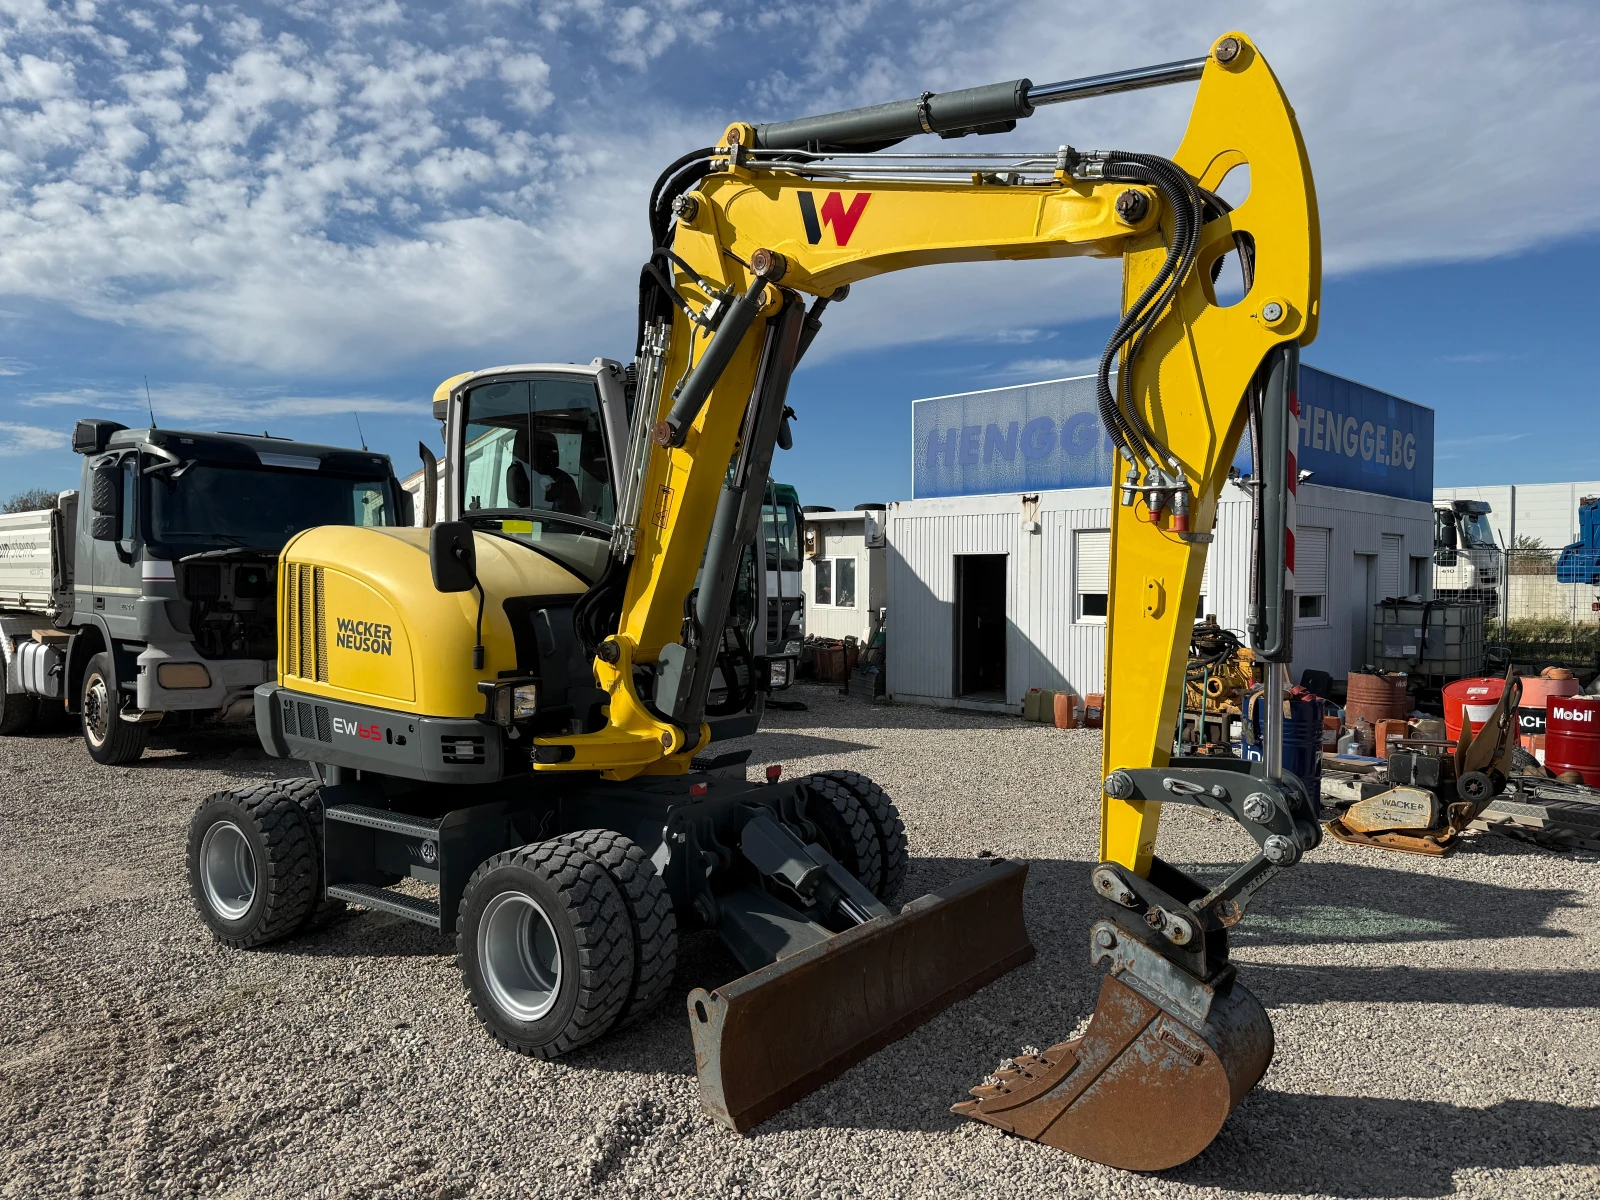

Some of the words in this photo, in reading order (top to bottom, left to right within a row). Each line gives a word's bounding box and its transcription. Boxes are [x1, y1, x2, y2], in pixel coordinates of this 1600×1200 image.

[926, 412, 1114, 467] HENGG
[336, 617, 392, 641] WACKER
[336, 632, 392, 656] NEUSON
[1553, 706, 1592, 722] Mobil
[333, 717, 382, 742] EW65
[1382, 798, 1425, 811] WACKER
[423, 843, 434, 858] 20
